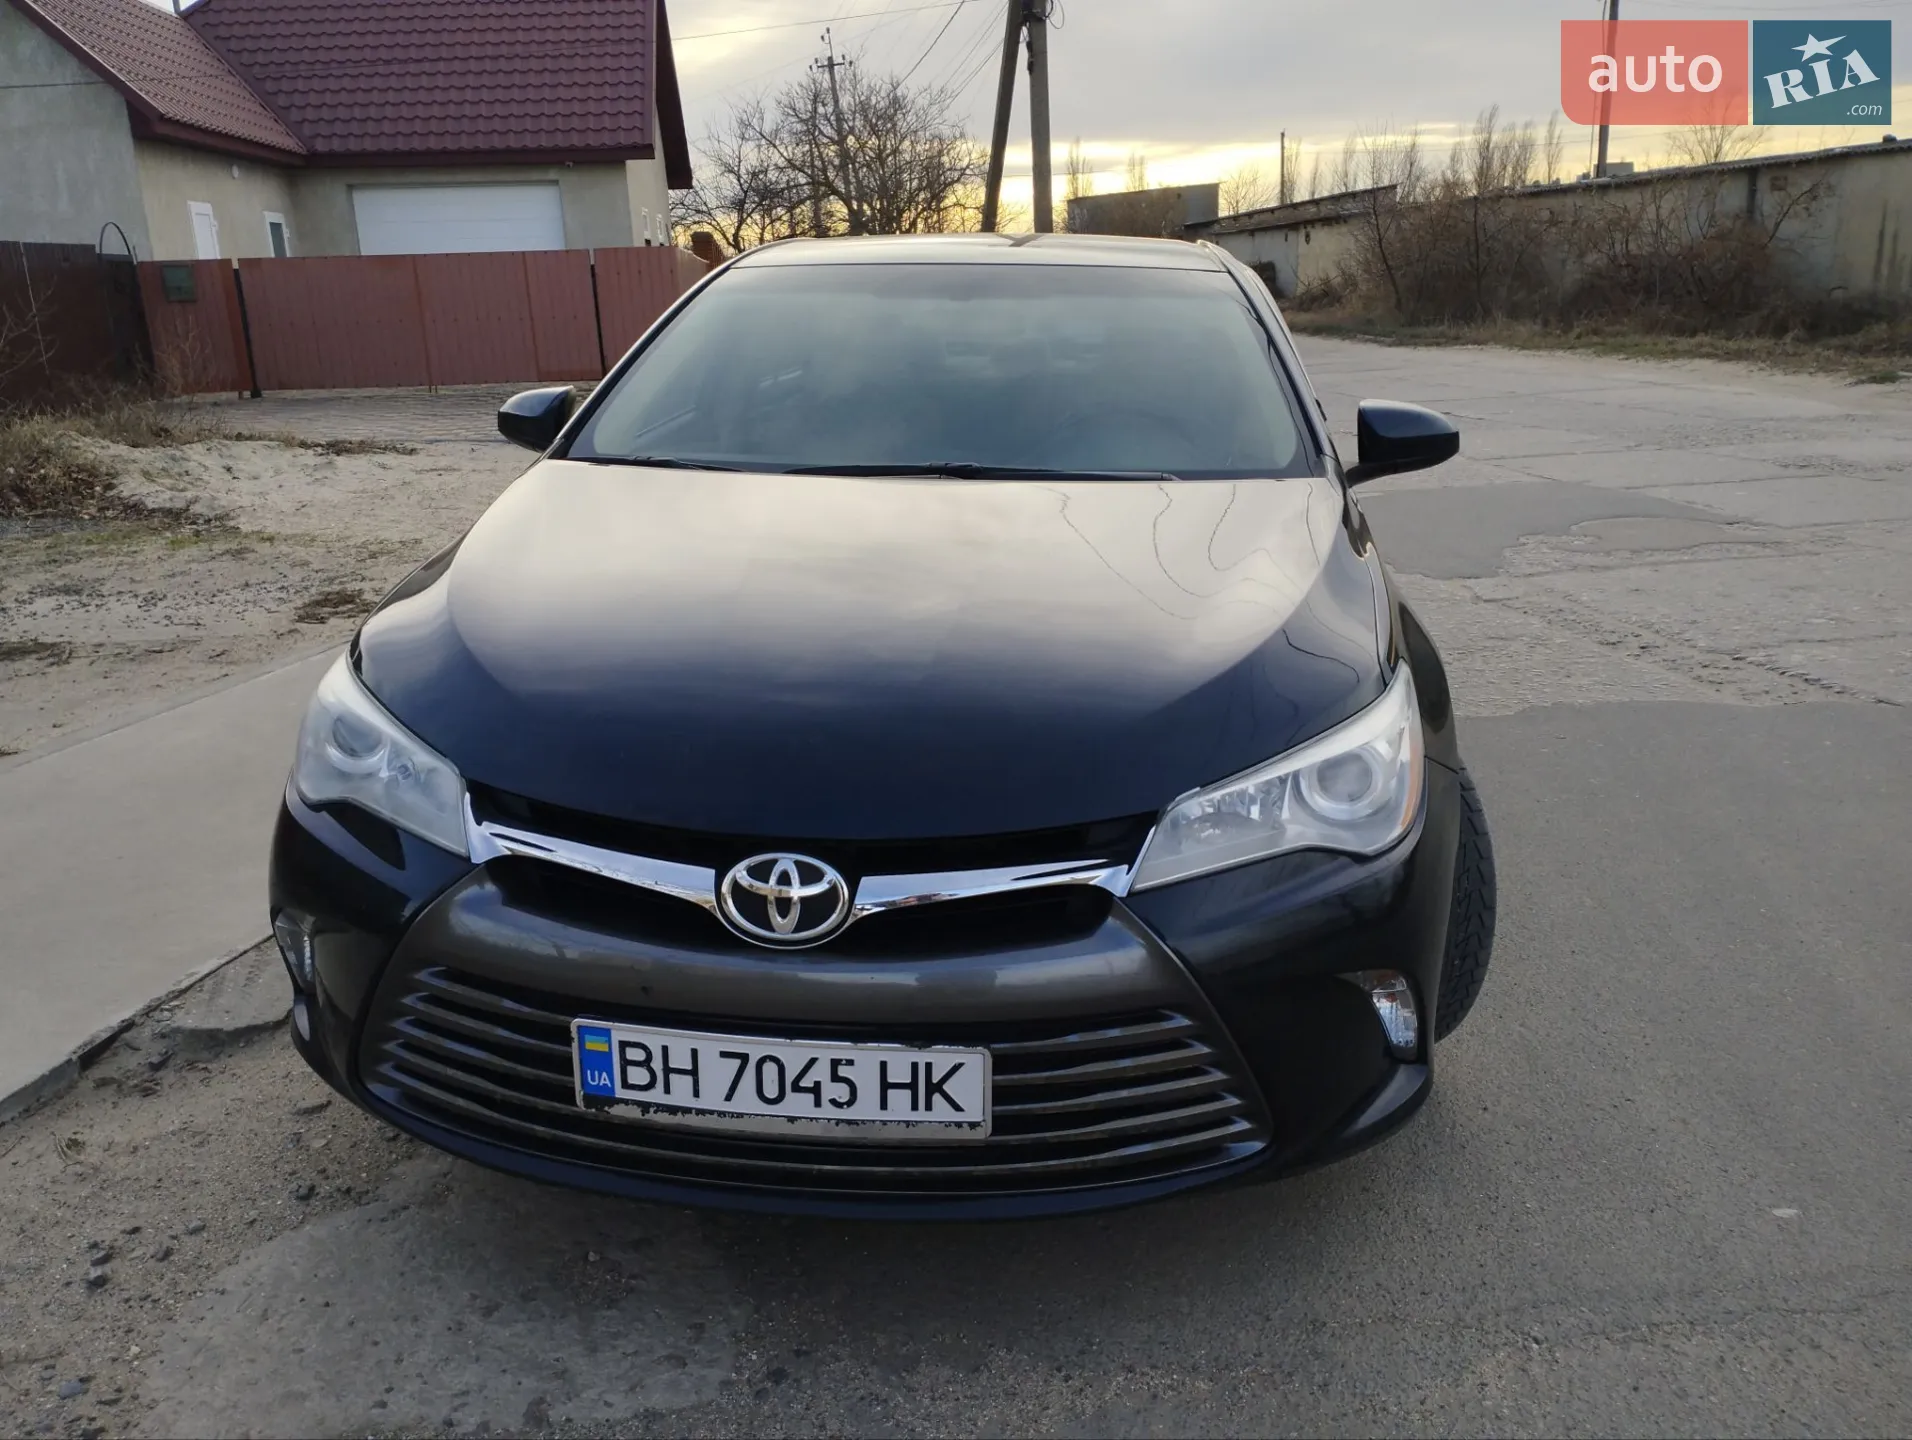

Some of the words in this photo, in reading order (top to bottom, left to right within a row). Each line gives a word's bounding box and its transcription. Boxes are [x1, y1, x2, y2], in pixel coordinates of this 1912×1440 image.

[587, 1069, 611, 1088] UA
[618, 1040, 700, 1098] BH
[719, 1051, 858, 1109] 7045
[879, 1060, 965, 1112] HK
